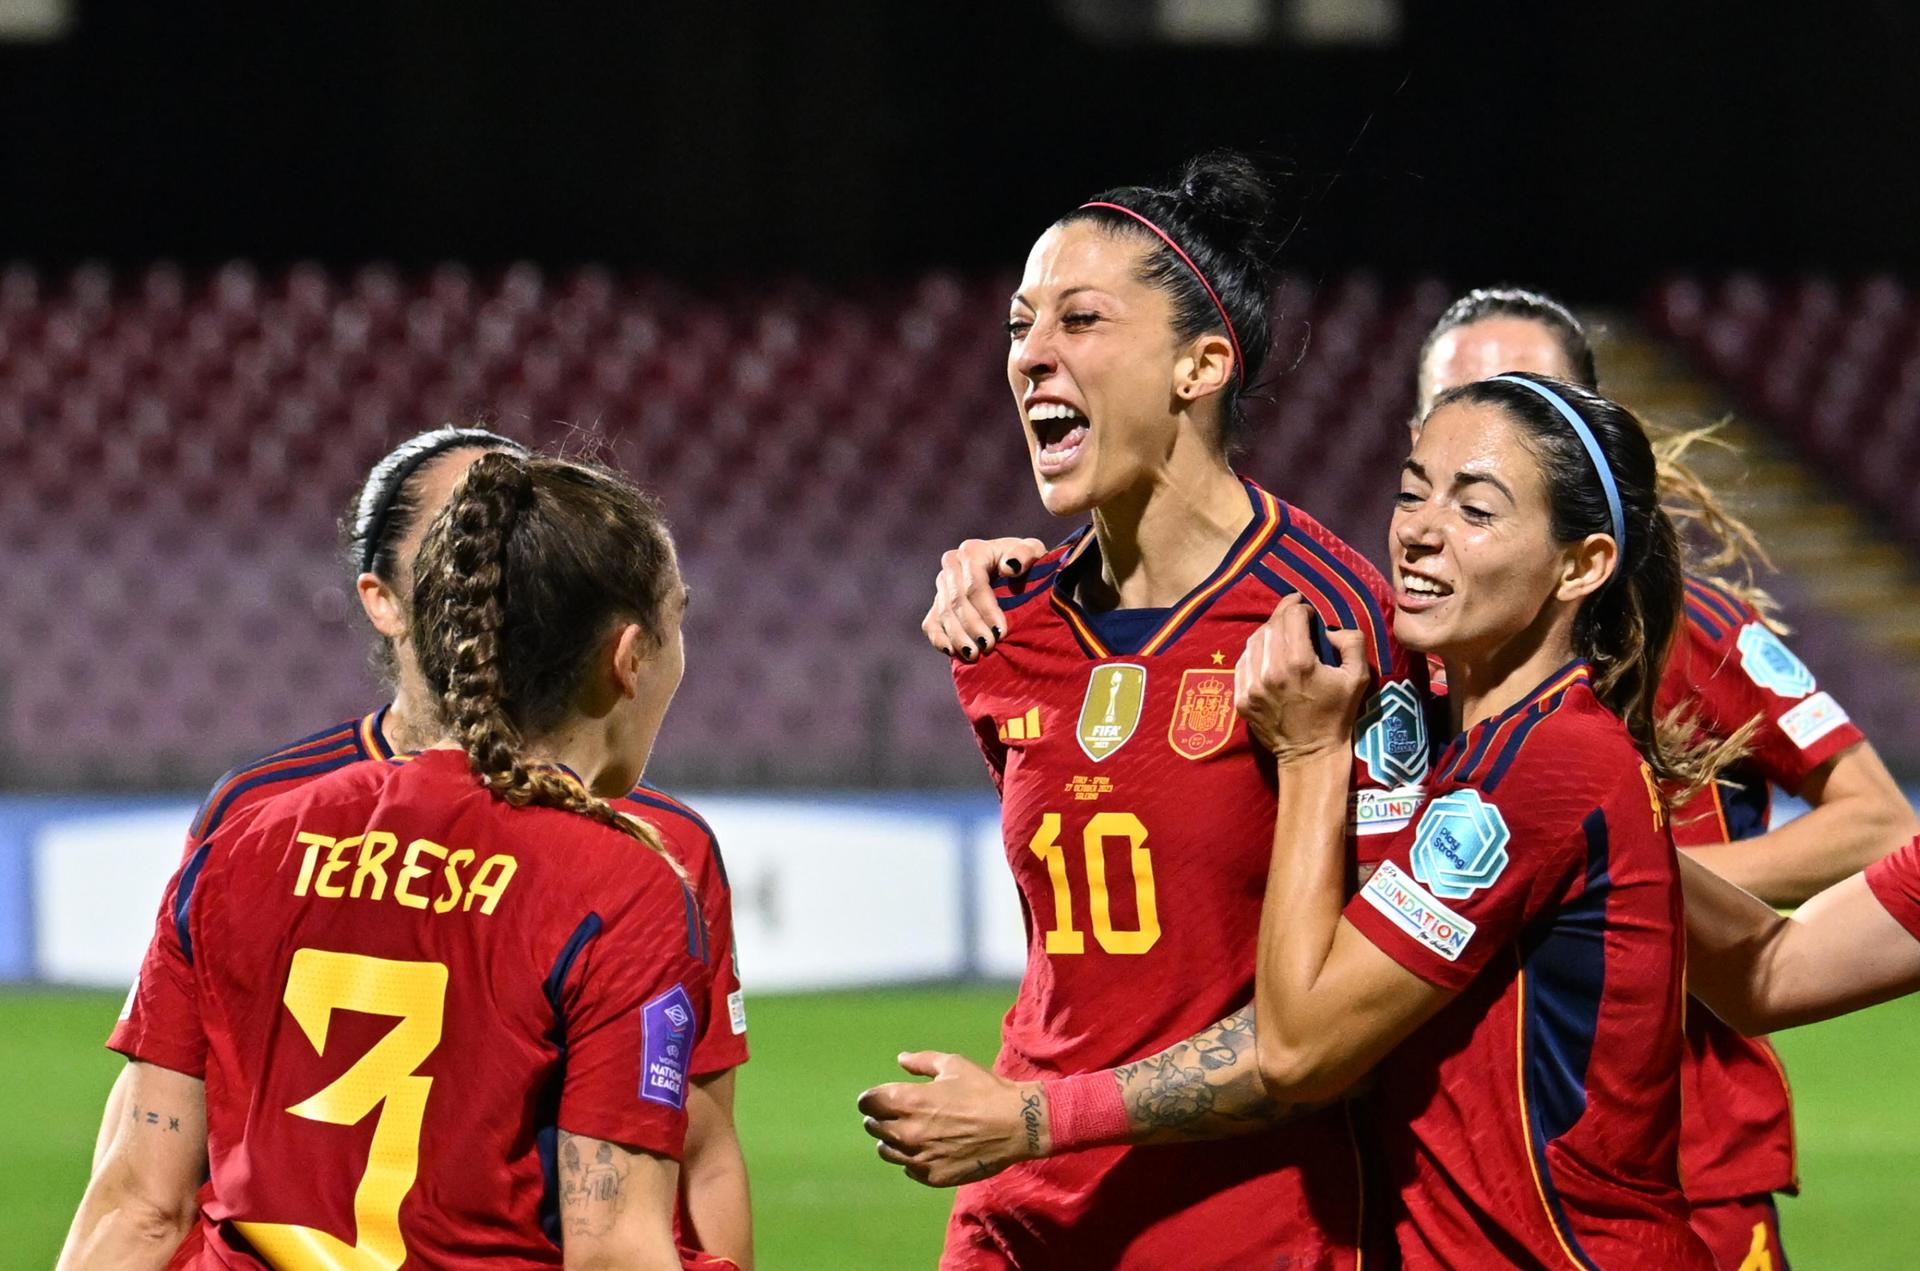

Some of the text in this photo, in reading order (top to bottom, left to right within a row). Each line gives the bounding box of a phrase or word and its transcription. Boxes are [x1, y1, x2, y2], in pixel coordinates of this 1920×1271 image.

[1092, 725, 1118, 736] FIFA
[1389, 741, 1417, 754] Strong
[1440, 827, 1461, 850] Play
[1433, 837, 1466, 869] Strong
[293, 831, 518, 916] TERESA
[1029, 812, 1161, 954] 10
[651, 1074, 680, 1095] LEAGUE
[232, 947, 449, 1271] 3
